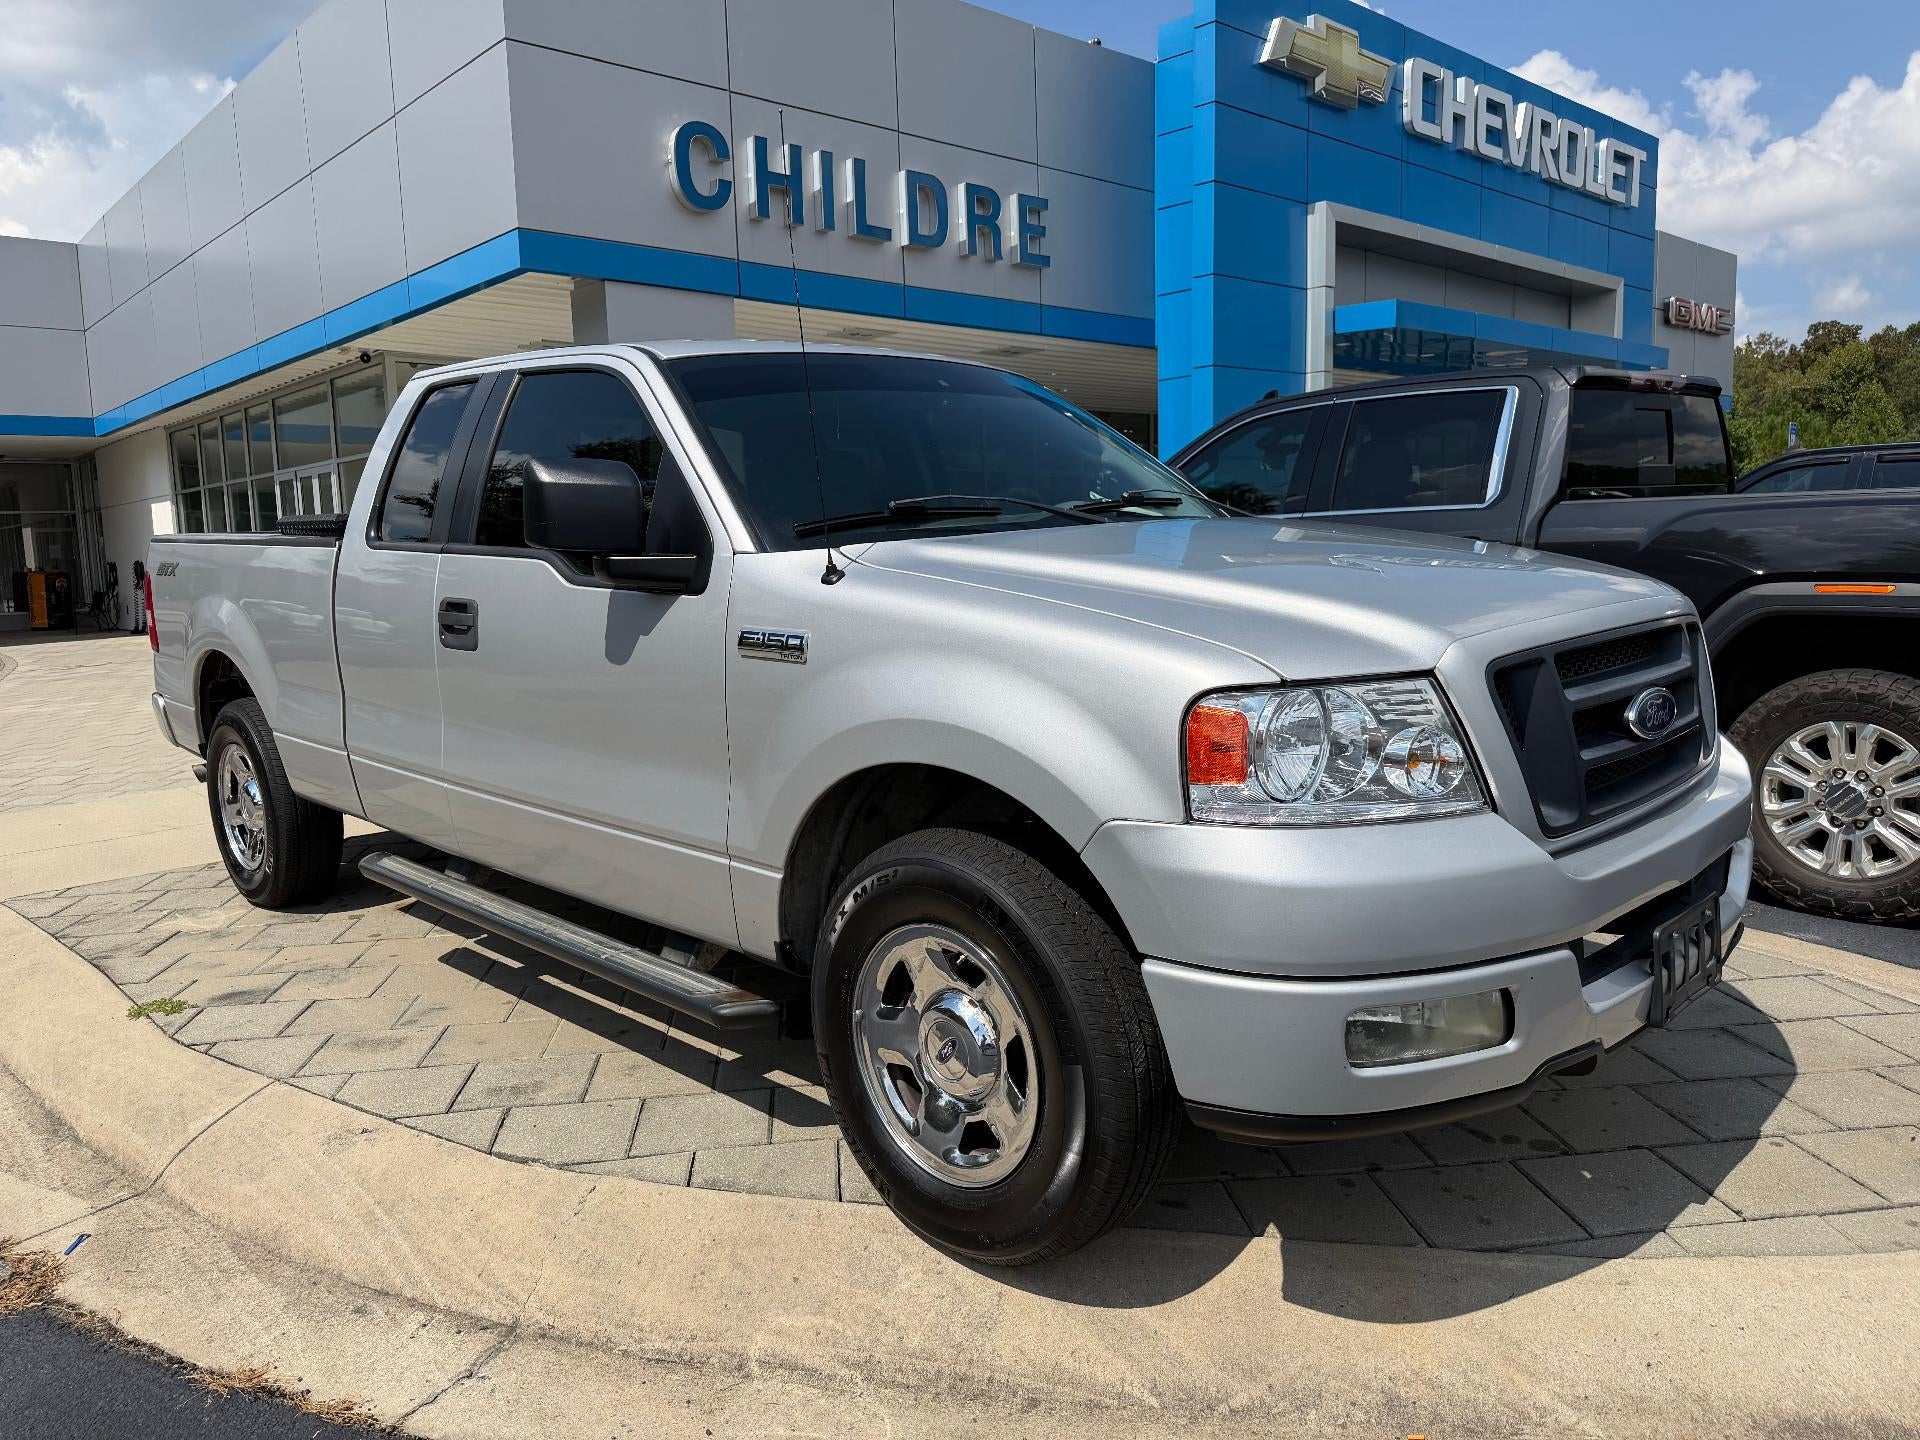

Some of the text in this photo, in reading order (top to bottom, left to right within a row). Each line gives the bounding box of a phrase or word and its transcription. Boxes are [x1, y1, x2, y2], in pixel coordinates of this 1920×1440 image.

[1403, 57, 1647, 208] CHEVROLET
[667, 120, 1051, 269] CHILDRE
[1664, 296, 1730, 335] GMC
[780, 653, 803, 661] TRITON
